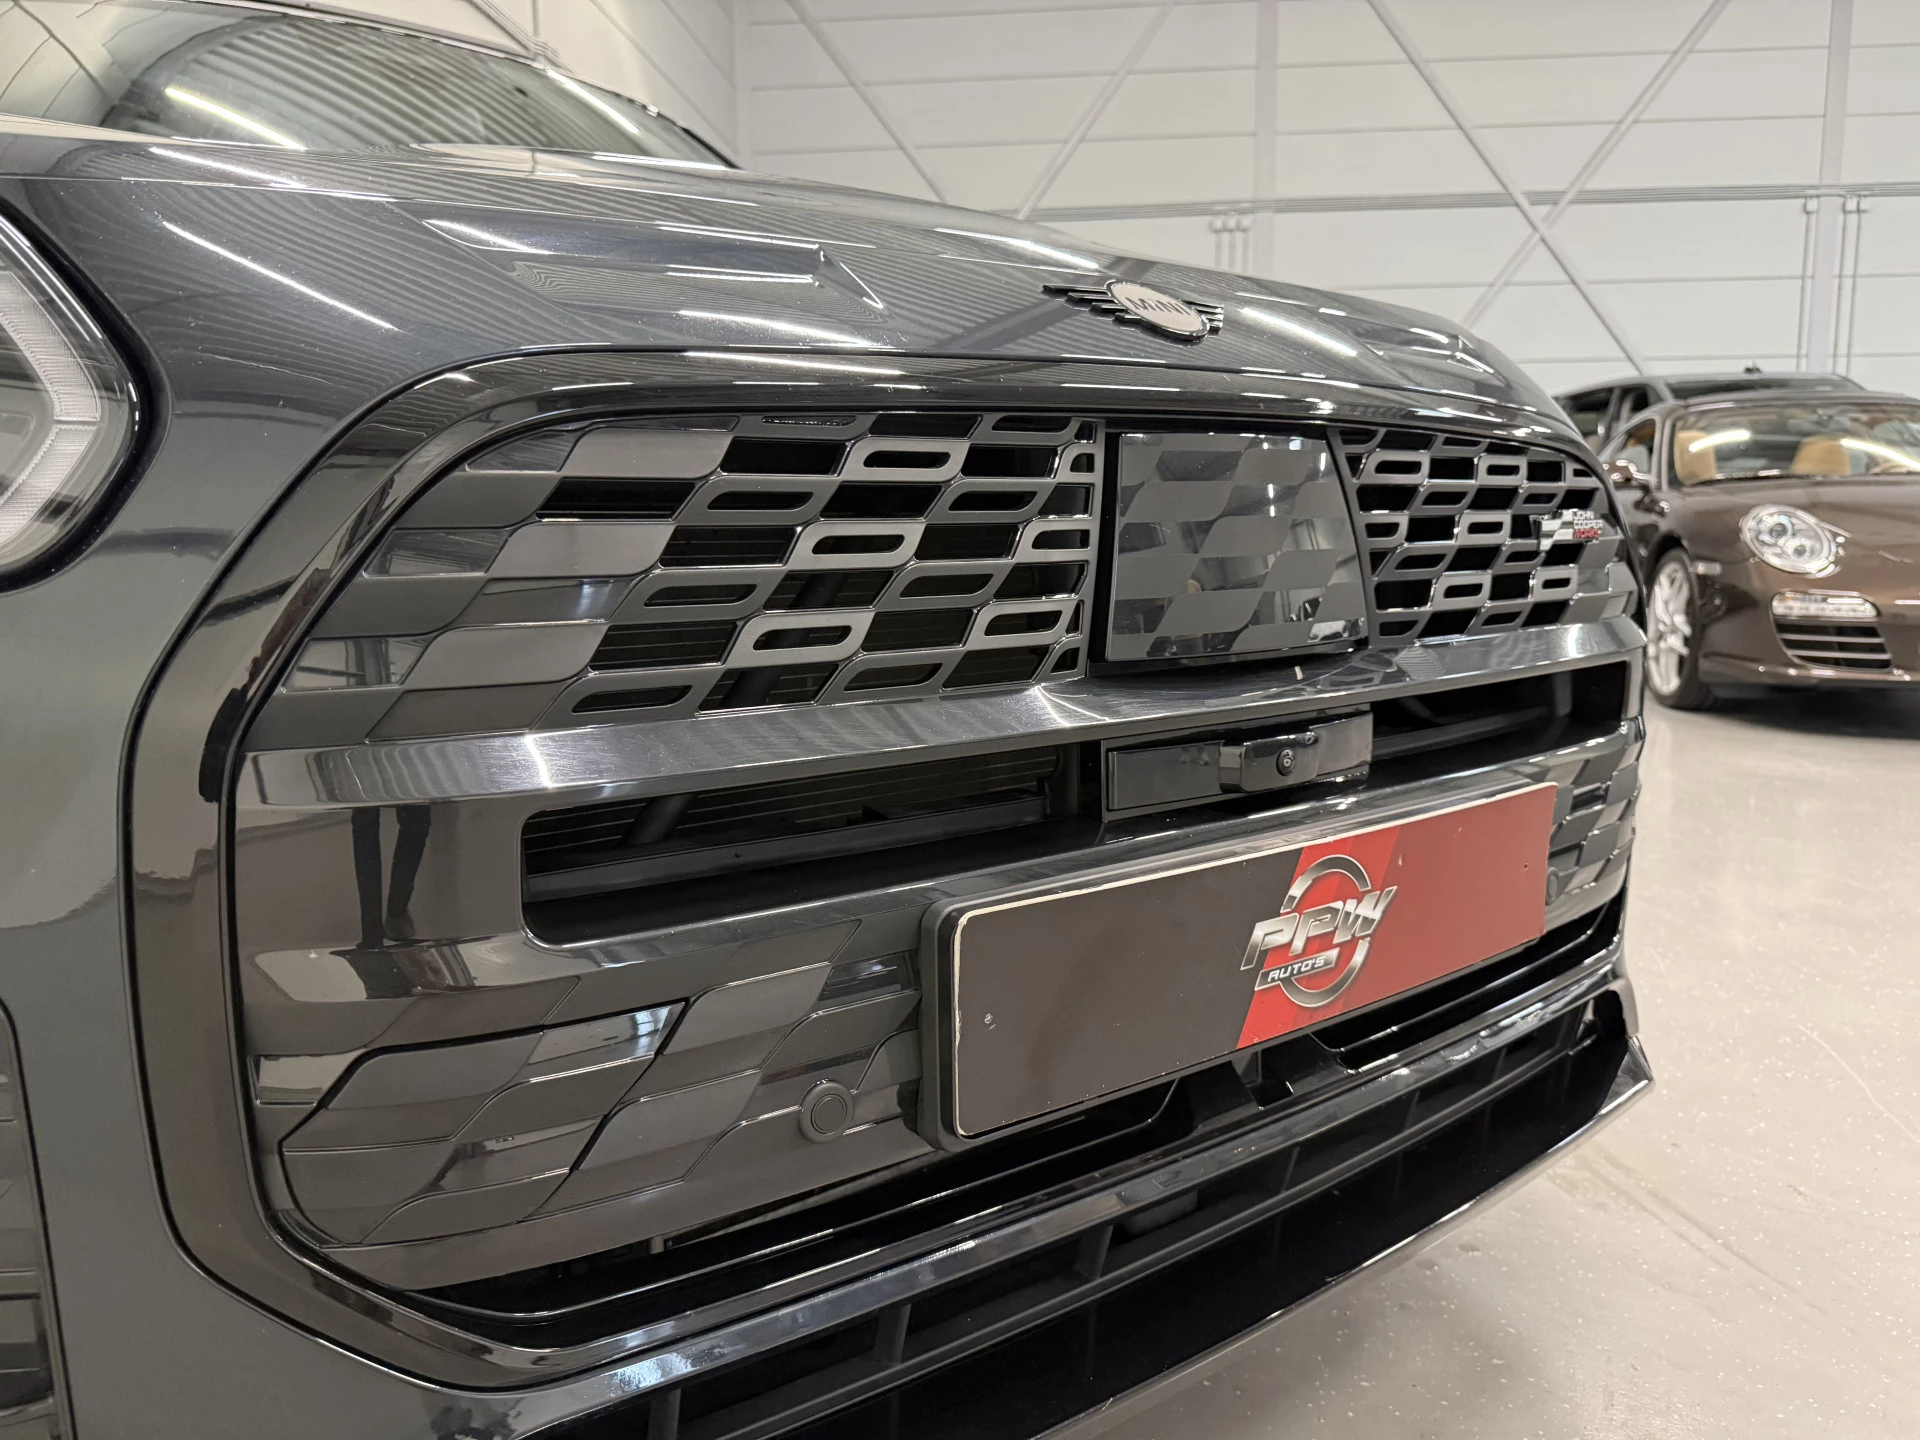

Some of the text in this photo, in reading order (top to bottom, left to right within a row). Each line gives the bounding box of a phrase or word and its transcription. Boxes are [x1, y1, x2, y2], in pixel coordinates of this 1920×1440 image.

[1122, 297, 1192, 316] MINI
[1573, 511, 1594, 520] JOHN
[1573, 520, 1604, 529] COOPER
[1574, 529, 1601, 538] WORKS
[1240, 885, 1398, 970] PPW
[1267, 955, 1326, 982] AUTO'S
